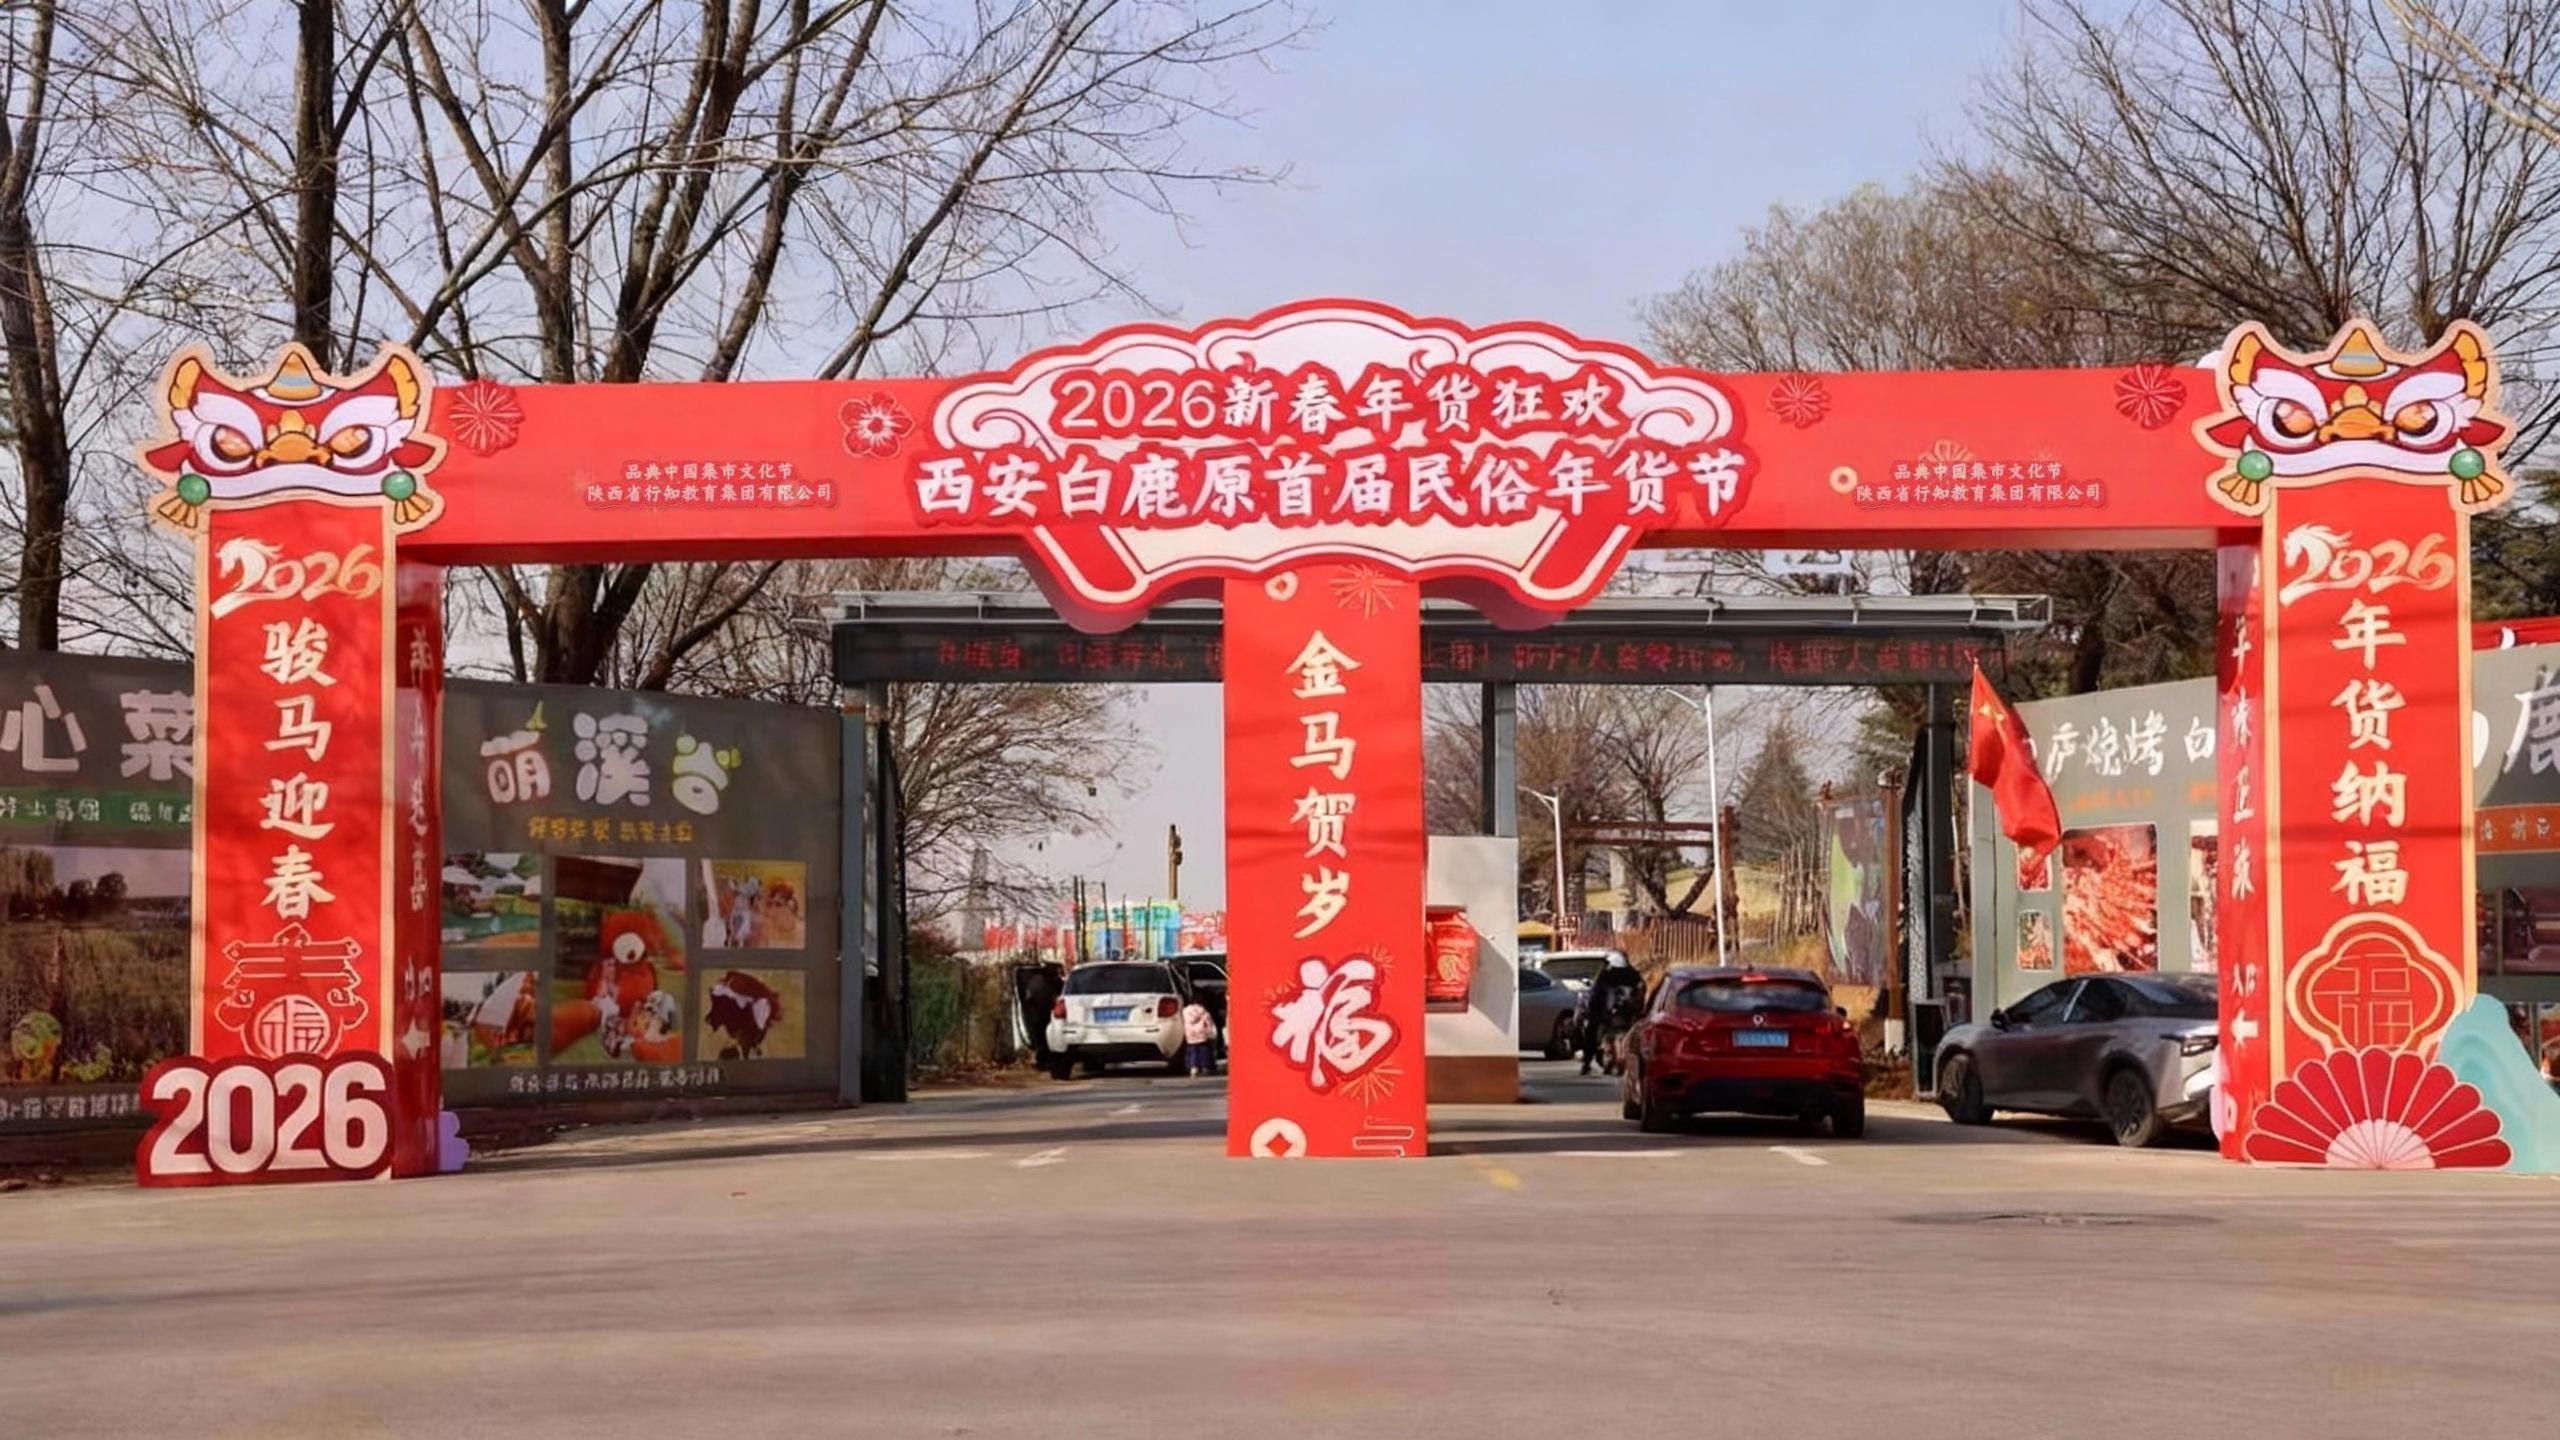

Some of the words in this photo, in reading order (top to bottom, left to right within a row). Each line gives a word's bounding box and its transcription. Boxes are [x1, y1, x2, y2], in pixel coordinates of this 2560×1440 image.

[1061, 373, 1620, 432] 2026新春年货狂欢
[587, 484, 832, 503] 陕西省行知教育集团有限公司
[916, 451, 1744, 520] 西安白鹿原首届民俗年货节
[1856, 484, 2101, 503] 陕西省行知教育集团有限公司
[209, 536, 384, 620] 2026
[2280, 523, 2456, 606] 2026
[259, 618, 338, 921] 骏马迎春
[1286, 630, 1363, 938] 金马贺岁
[2330, 598, 2408, 906] 年货纳福
[1272, 960, 1396, 1086] 福
[150, 1061, 389, 1176] 2026
